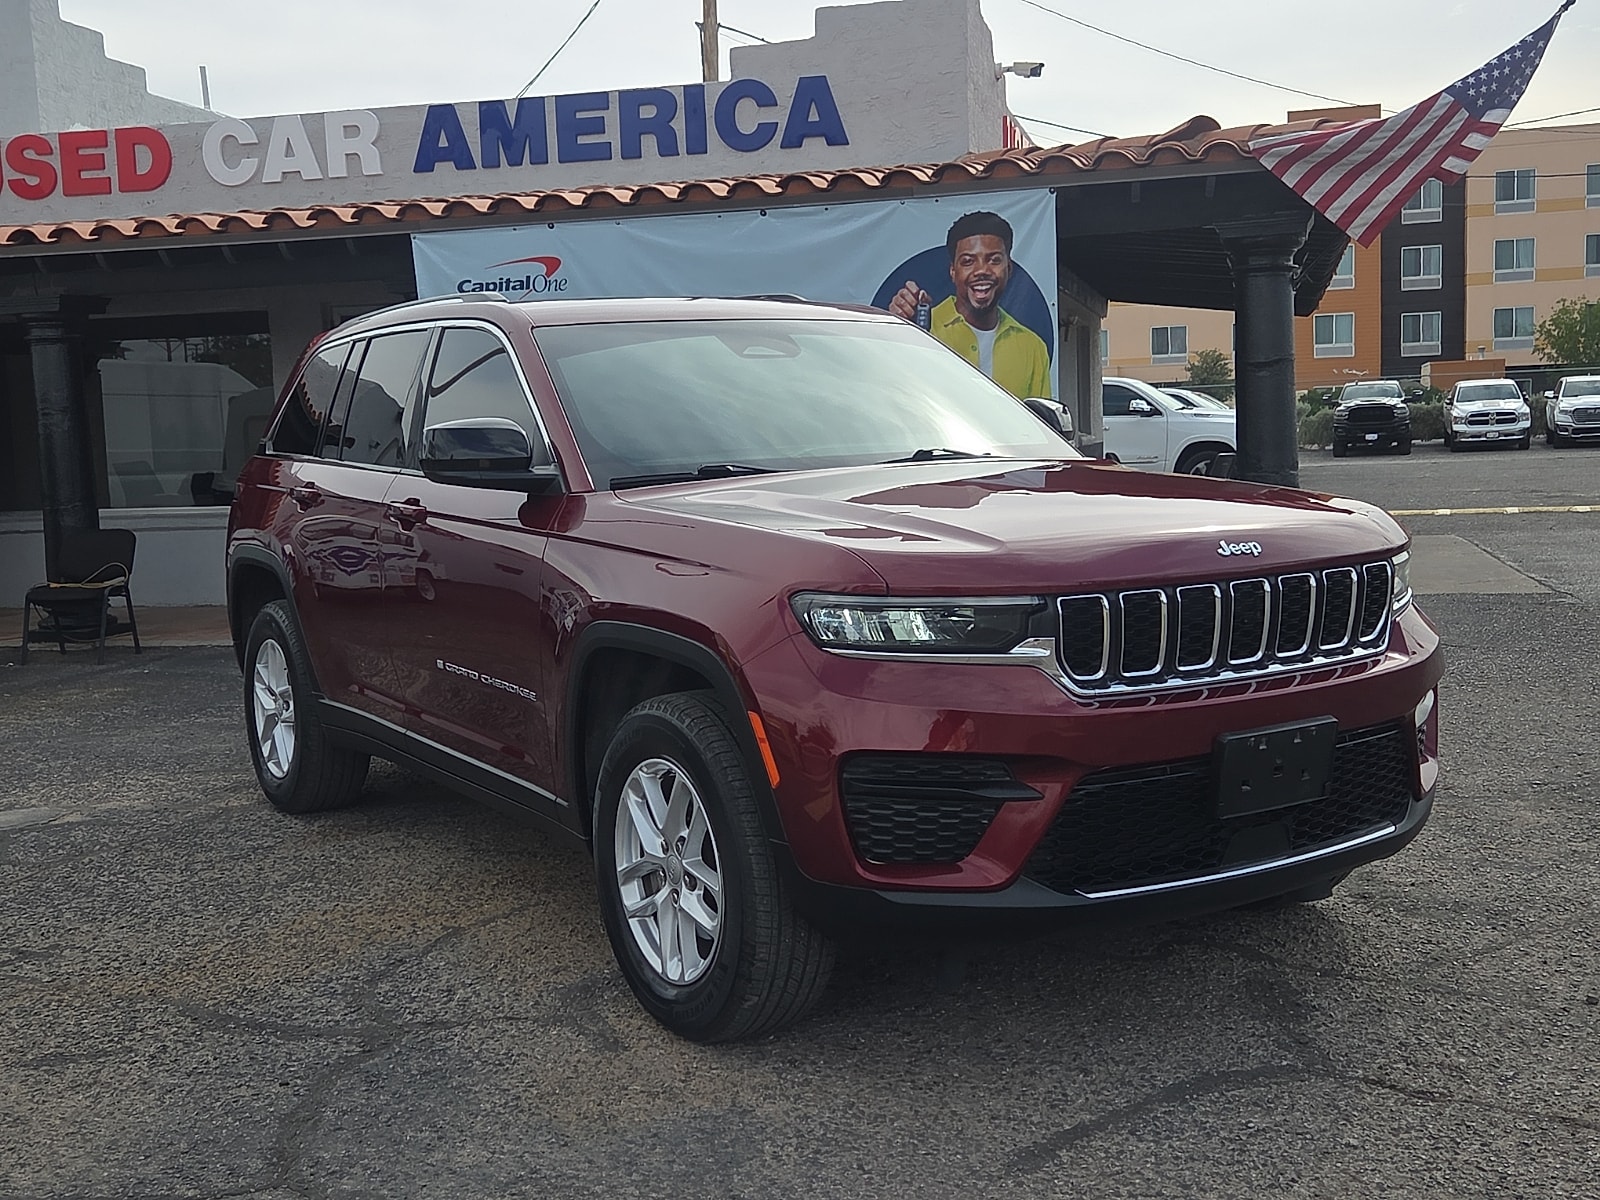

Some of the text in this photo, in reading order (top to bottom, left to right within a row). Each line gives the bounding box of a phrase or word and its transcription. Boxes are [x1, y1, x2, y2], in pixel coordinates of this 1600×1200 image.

[0, 75, 849, 201] SED CAR AMERICA
[1217, 540, 1262, 557] Jeep
[445, 662, 537, 702] GRAND CHEROKEE
